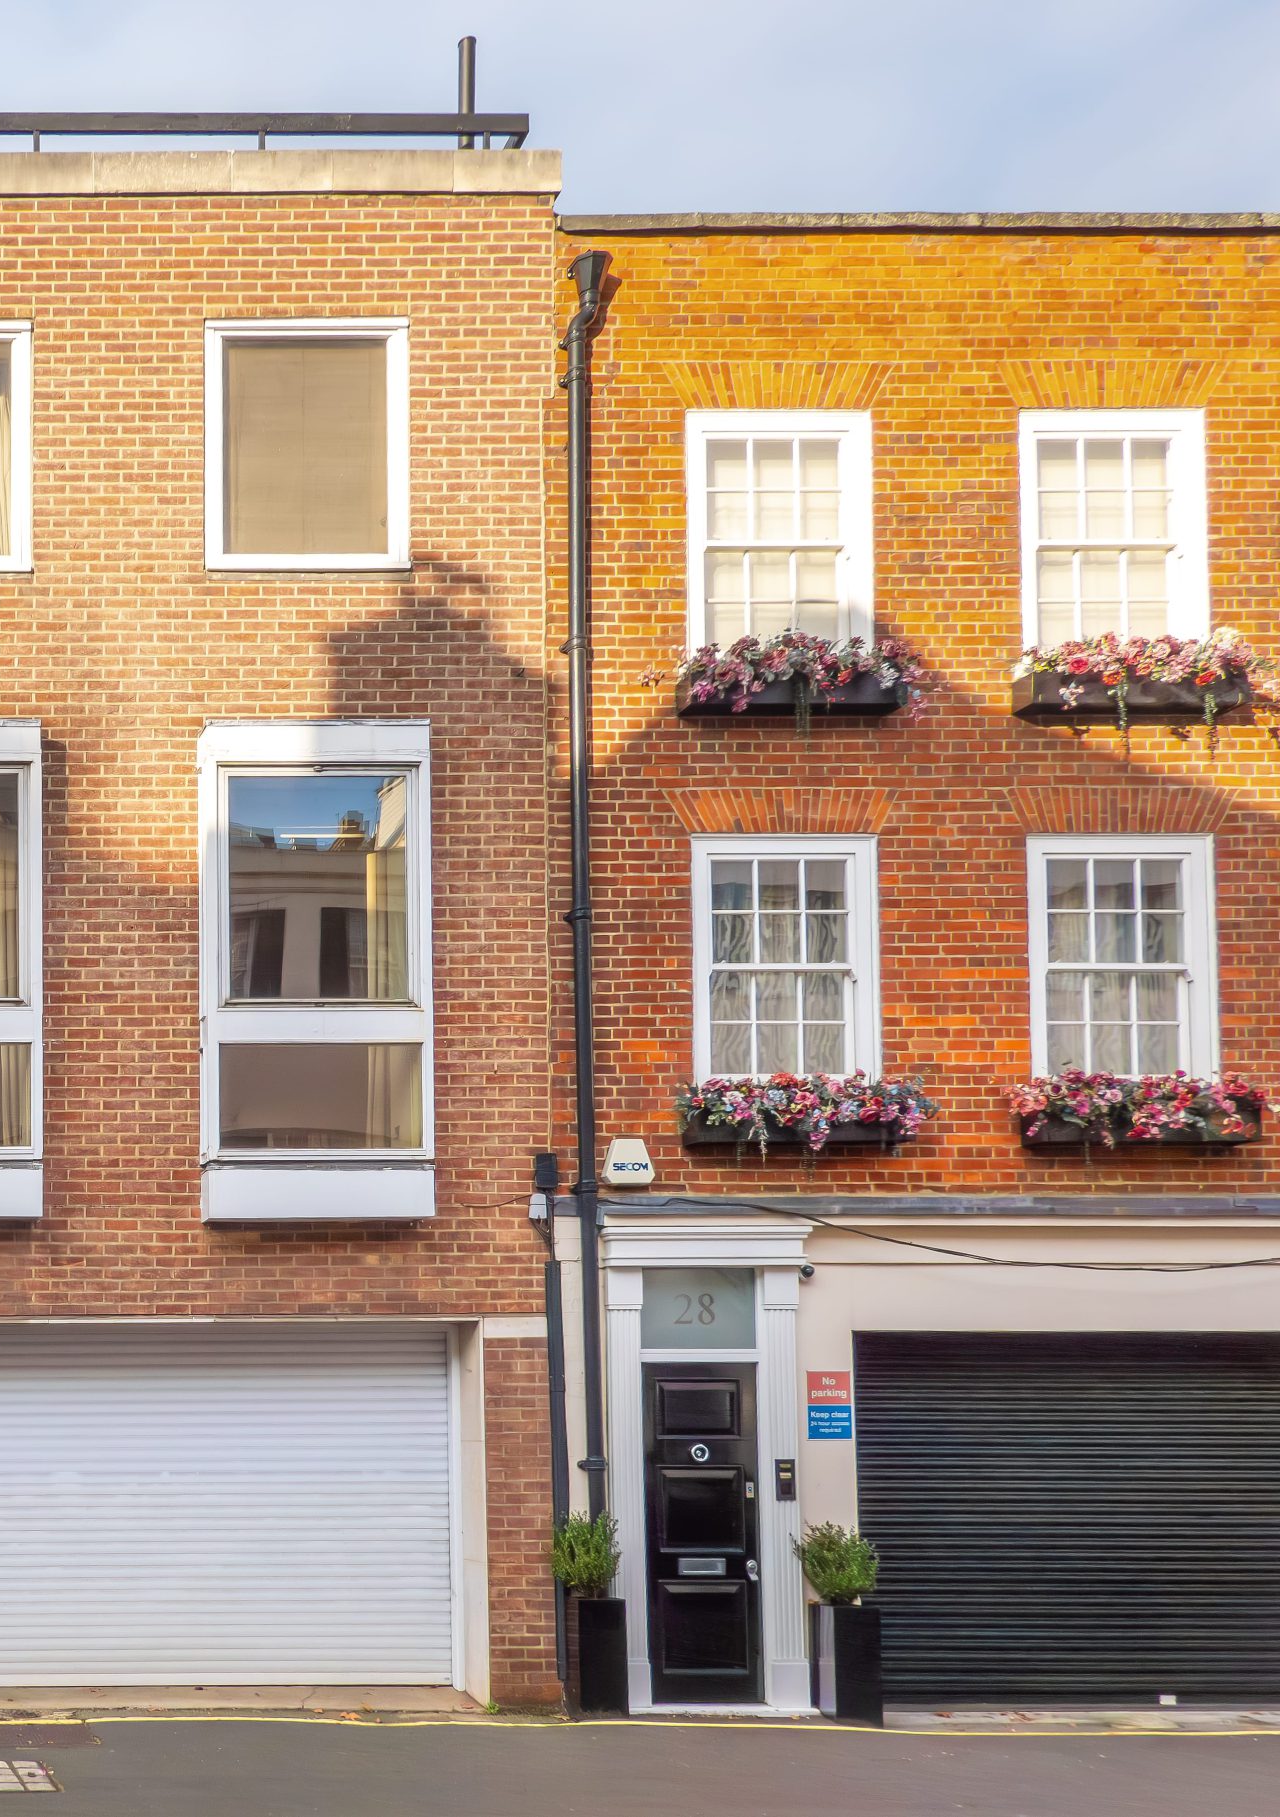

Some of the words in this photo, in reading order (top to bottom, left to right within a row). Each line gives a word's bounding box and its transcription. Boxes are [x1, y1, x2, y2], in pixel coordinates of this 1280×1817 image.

[612, 1162, 649, 1172] SECOM
[673, 1293, 715, 1325] 28
[822, 1377, 836, 1386] No
[811, 1389, 847, 1399] parking
[810, 1411, 830, 1419] Keep
